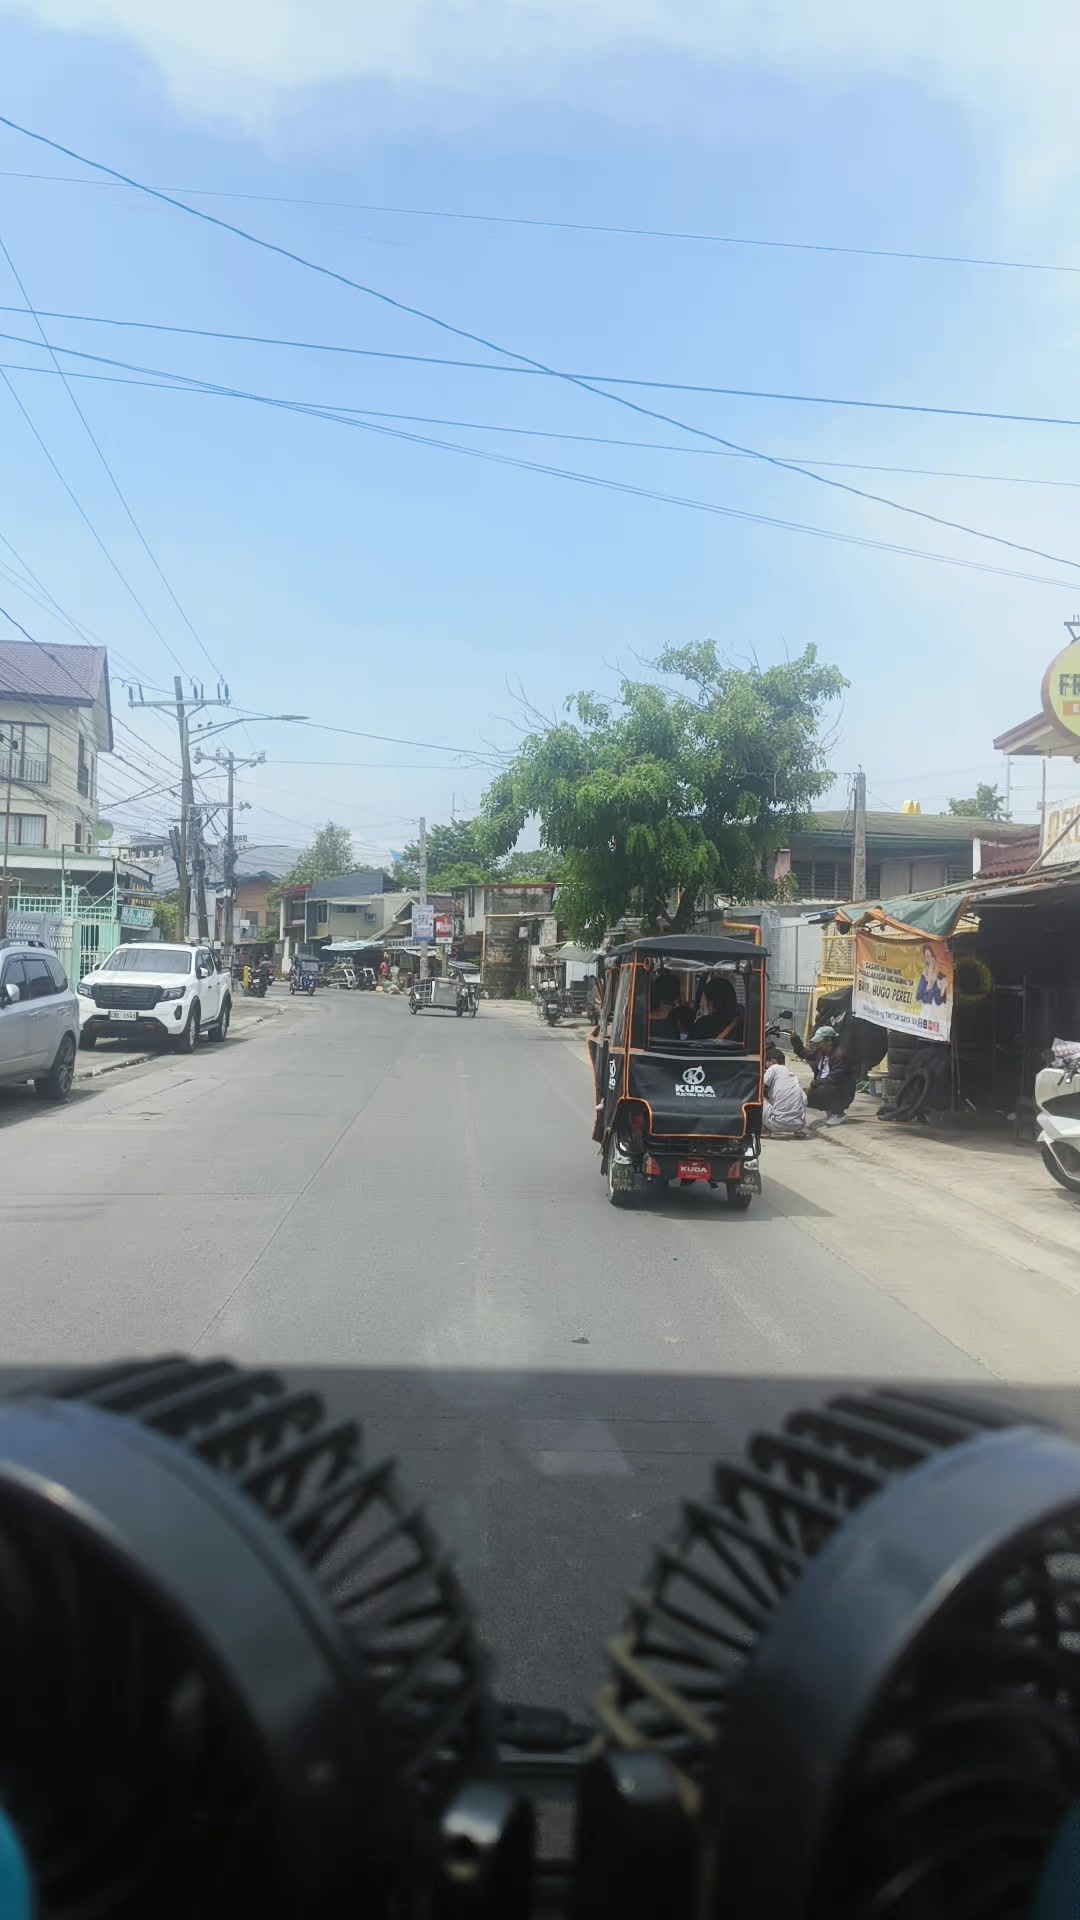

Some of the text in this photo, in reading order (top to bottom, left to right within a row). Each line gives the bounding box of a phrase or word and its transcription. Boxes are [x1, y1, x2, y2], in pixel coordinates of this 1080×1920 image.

[872, 984, 891, 999] HUGO
[675, 1084, 715, 1094] KUDA
[680, 1165, 708, 1173] KUDA
